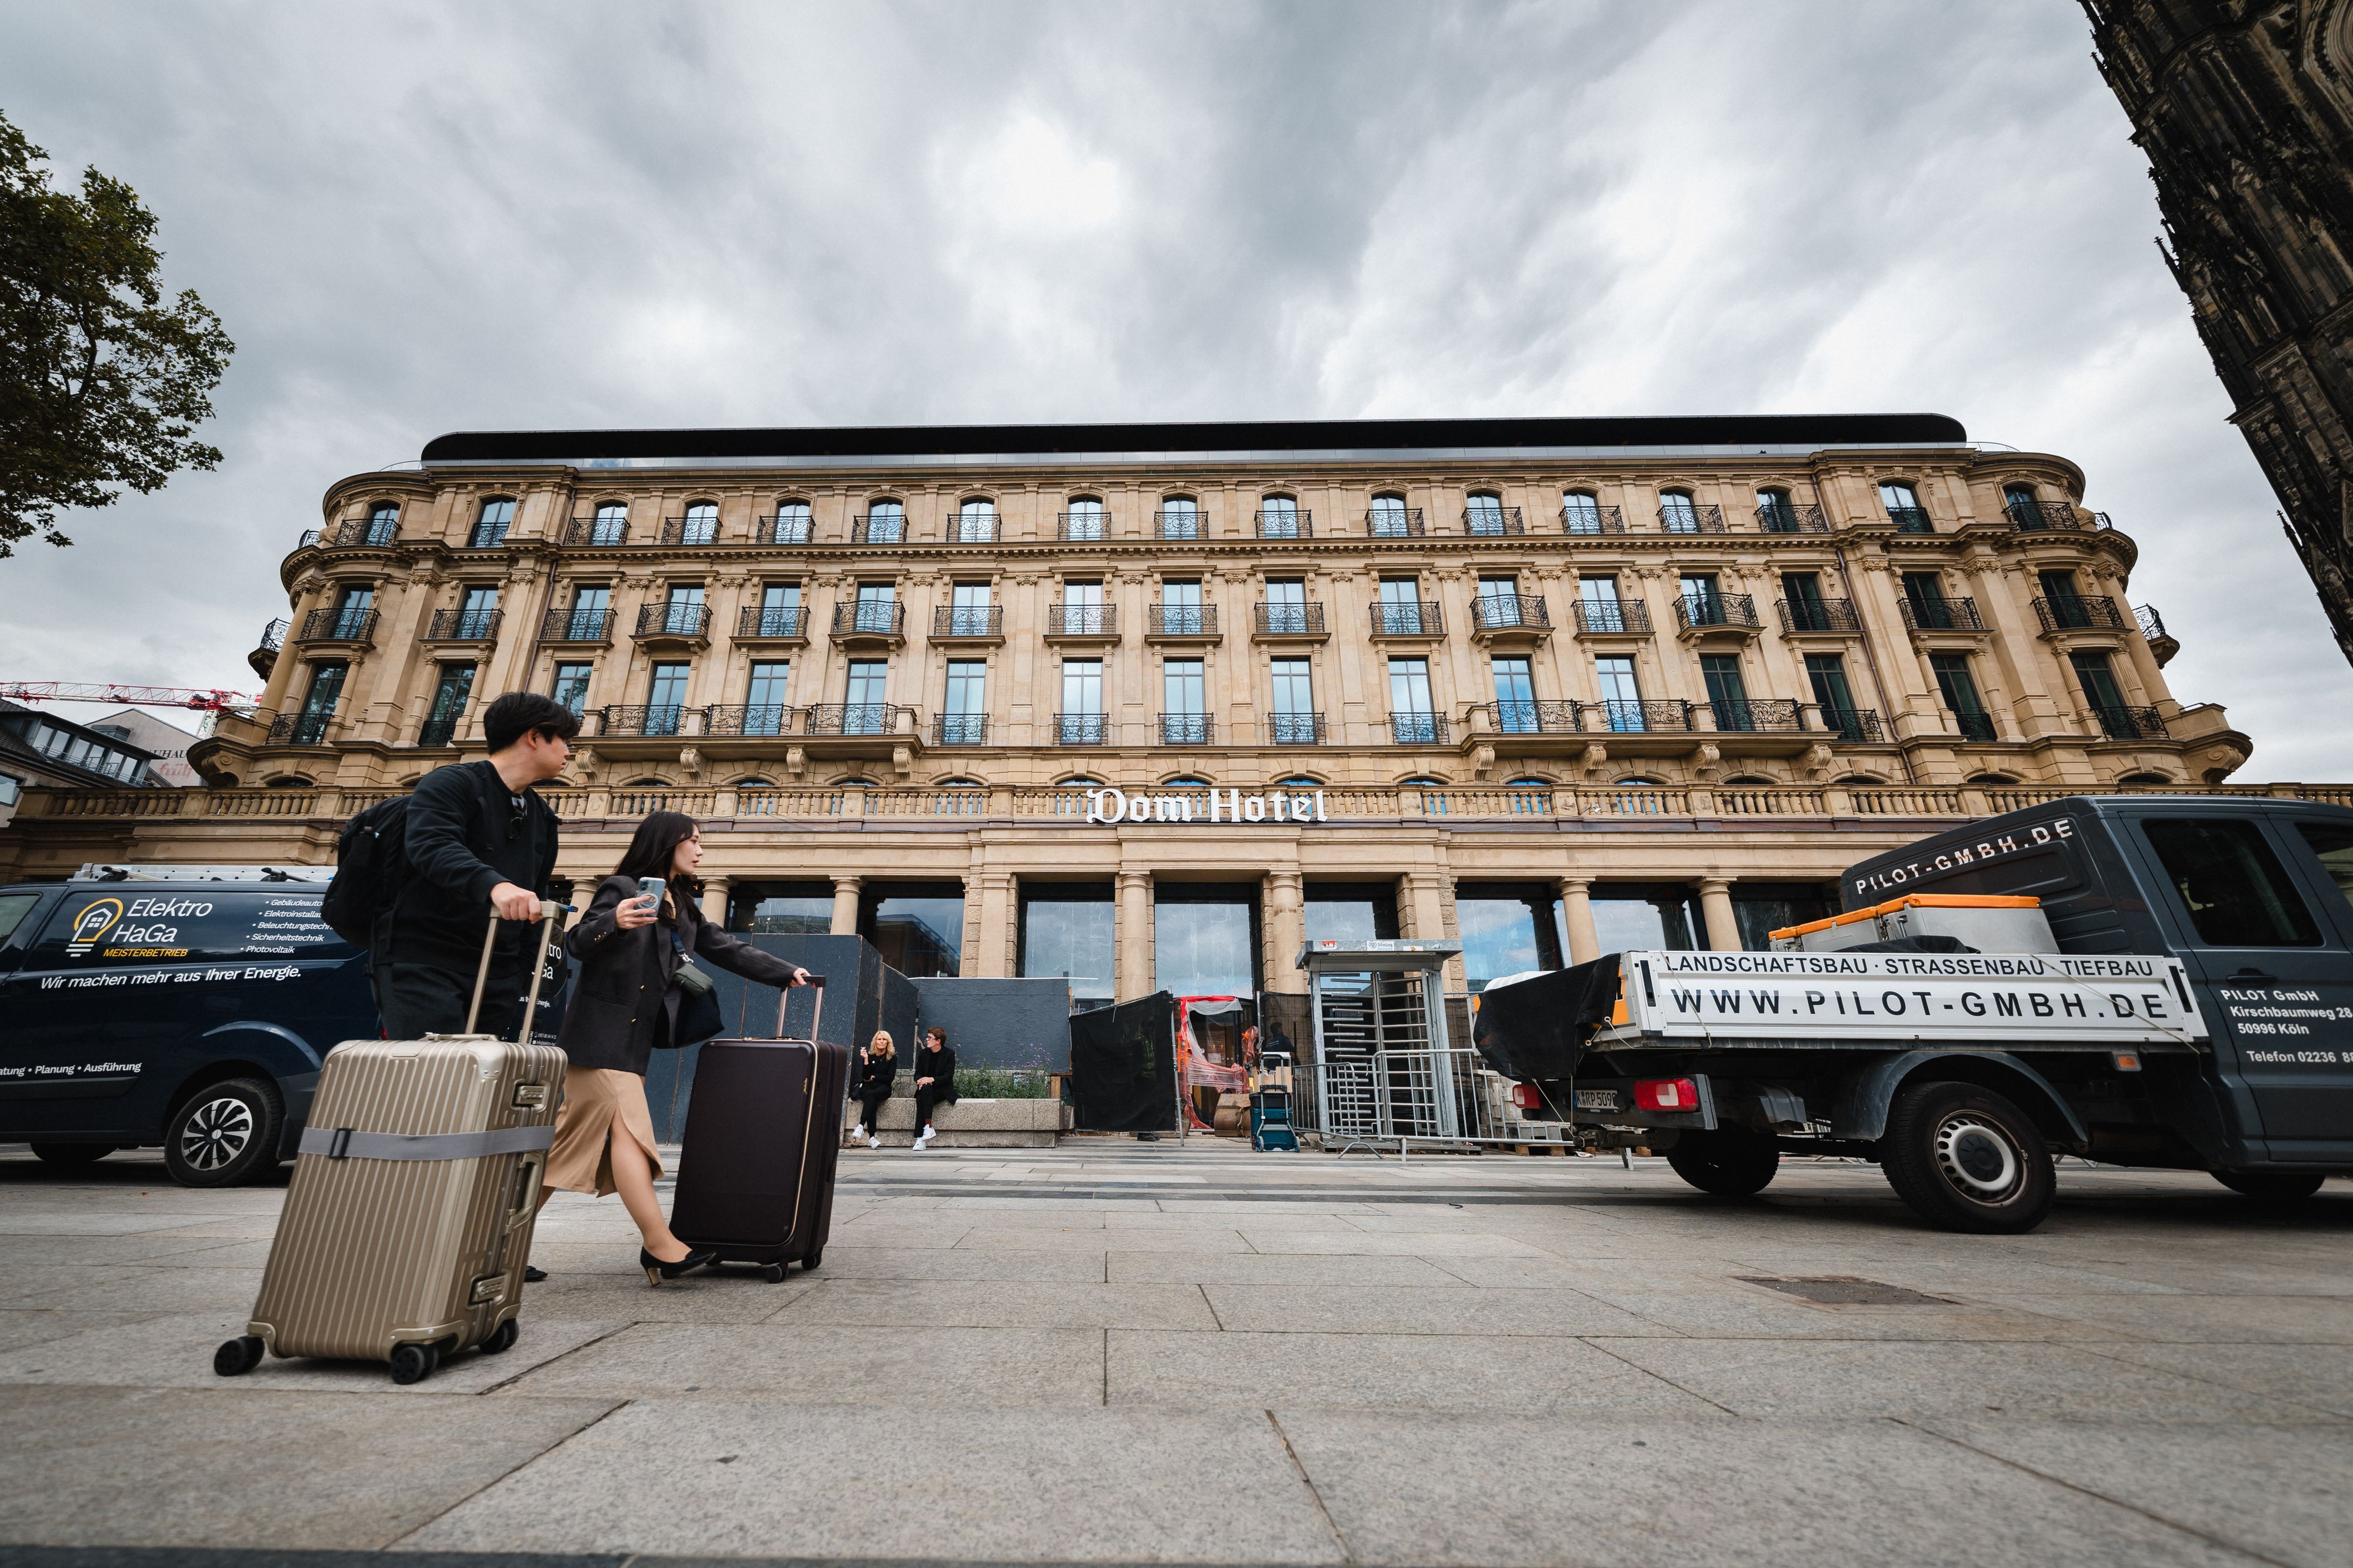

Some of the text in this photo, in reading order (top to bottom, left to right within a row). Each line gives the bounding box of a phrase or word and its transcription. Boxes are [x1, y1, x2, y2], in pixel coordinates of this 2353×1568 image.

[1086, 788, 1328, 824] Dom Hotel
[1855, 819, 2073, 895] PILOT-GMBH.DE
[126, 898, 213, 917] Elektro
[111, 923, 178, 943] HaGa
[251, 933, 325, 942] Sicherheitstechnik
[103, 949, 188, 957] MEISTERBETRIEB
[245, 945, 296, 954] Photovoltaik
[1665, 956, 2153, 976] LANDSCHAFTSBAU STRASSENBAU TIEFBAU
[41, 965, 301, 989] Wir machen mehr aus Ihrer Energie.
[2220, 989, 2319, 1002] PILOT GmbH
[1671, 989, 2168, 1019] WWW.PILOT-GMBH.DE
[2229, 1006, 2353, 1020] Kirschbaumweg 28
[2238, 1023, 2309, 1035] 50996 Köln
[2246, 1050, 2296, 1062] Telefon
[2298, 1052, 2337, 1063] 02236
[35, 1065, 76, 1076] Planung
[84, 1062, 142, 1073] Ausführung
[1577, 1092, 1582, 1106] K
[1585, 1092, 1595, 1106] RP
